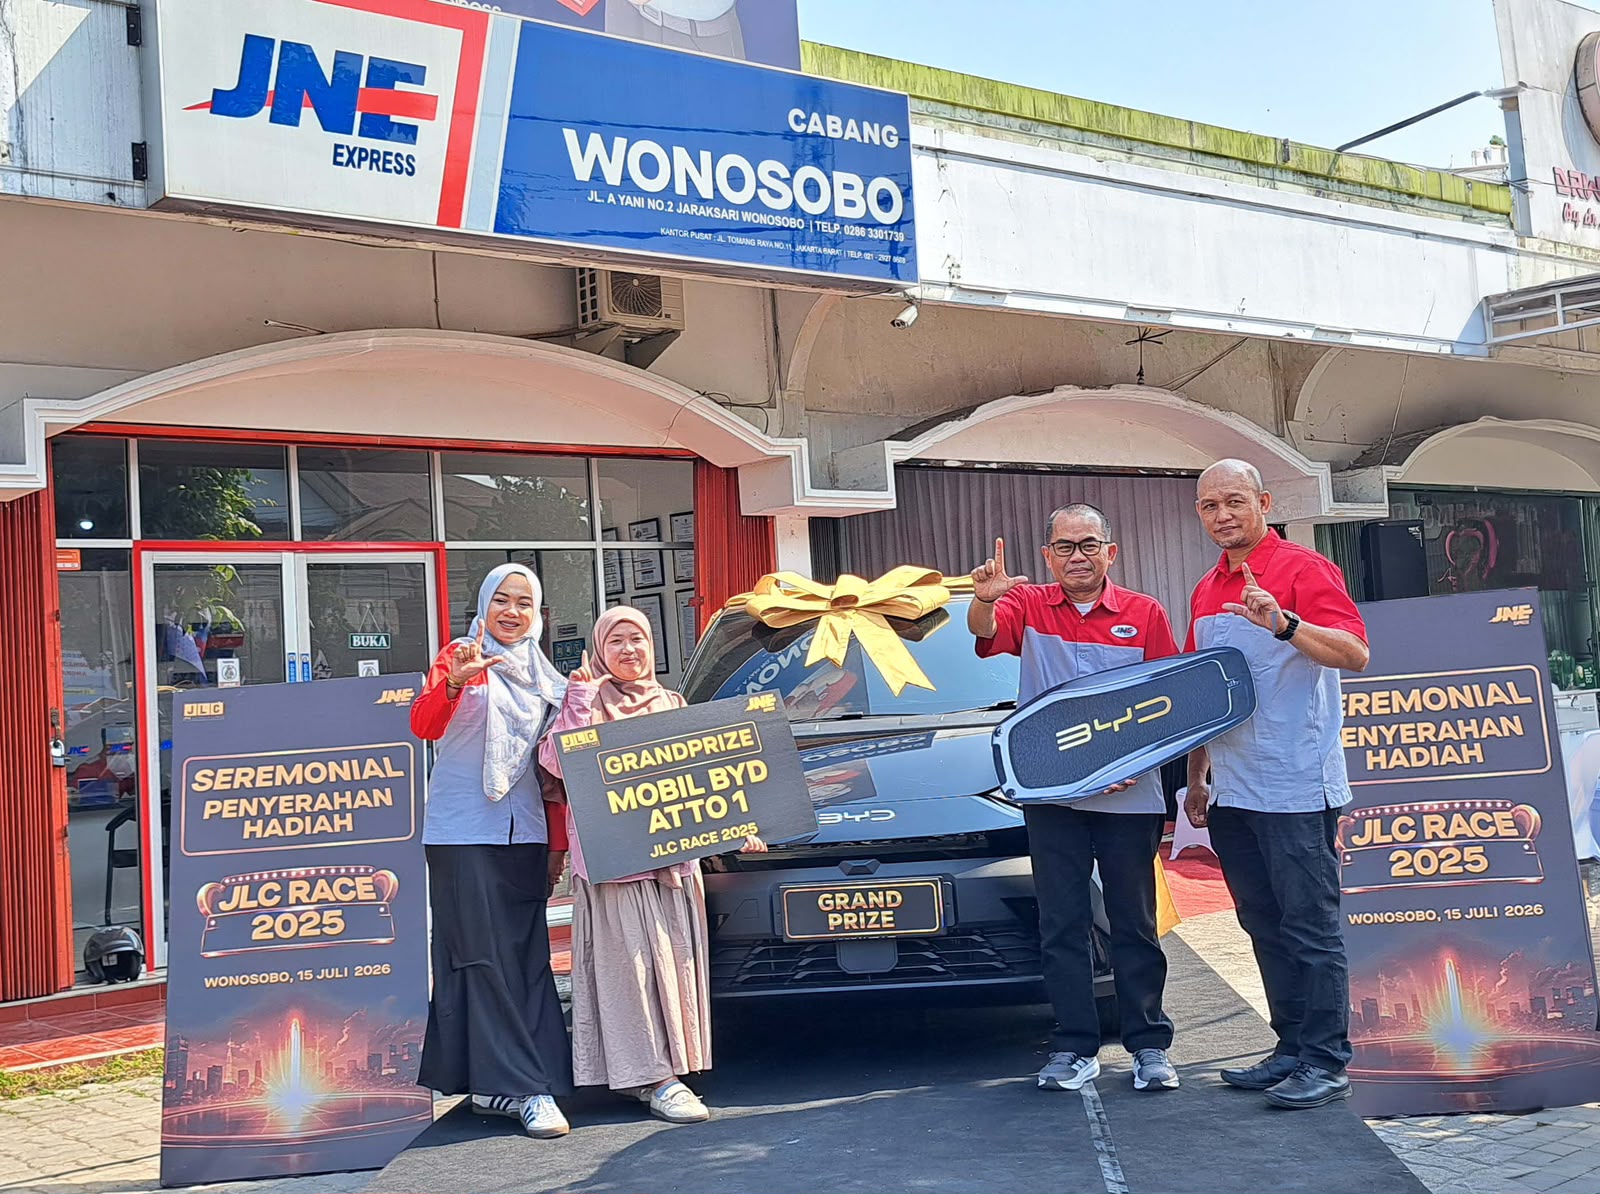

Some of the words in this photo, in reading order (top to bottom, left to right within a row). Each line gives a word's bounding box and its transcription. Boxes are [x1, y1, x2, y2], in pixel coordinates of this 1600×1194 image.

[208, 33, 439, 146] JNE
[788, 108, 899, 149] CABANG
[332, 143, 416, 177] EXPRESS
[562, 127, 904, 226] WONOSOBO
[587, 190, 605, 203] JL.
[607, 192, 617, 205] A
[617, 194, 645, 209] YANI
[647, 198, 674, 213] NO.2
[676, 202, 740, 222] JARAKSARI
[741, 211, 805, 229] WONOSOBO
[815, 220, 842, 235] TELP.
[843, 224, 866, 238] 0286
[867, 227, 905, 242] 3301739
[660, 227, 690, 238] KANTOR
[690, 230, 713, 241] PUSAT
[727, 236, 756, 247] TOMANG
[756, 239, 775, 248] RAYA
[795, 243, 823, 255] JAKARTA
[822, 247, 842, 256] BARAT
[1488, 604, 1534, 622] JNE
[352, 635, 388, 648] BUKA
[185, 702, 223, 716] JLC
[374, 687, 415, 704] JNE
[744, 693, 777, 711] JNE
[1341, 681, 1533, 718] REMONIAL
[562, 729, 598, 748] JLC
[1055, 695, 1173, 751] BYD
[1341, 715, 1524, 748] ENYERAHAN
[604, 728, 755, 776] GRANDPRIZE
[1366, 742, 1485, 771] HADIAH
[191, 756, 405, 793] SEREMONIAL
[606, 773, 706, 814] MOBIL
[707, 759, 768, 793] BYD
[202, 787, 394, 820] PENYERAHAN
[648, 795, 728, 834] ATTO
[732, 790, 750, 813] 1
[818, 809, 896, 824] BYD
[242, 812, 354, 840] HADIAH
[650, 841, 678, 859] JLC
[680, 831, 719, 851] RACE
[720, 822, 759, 840] 2025
[1351, 815, 1417, 847] JLC
[1422, 811, 1520, 840] RACE
[1388, 845, 1490, 877] 2025
[218, 881, 282, 912] JLC
[288, 876, 377, 905] RACE
[817, 890, 904, 912] GRAND
[251, 909, 346, 941] 2025
[828, 910, 896, 931] PRIZE
[1347, 909, 1441, 926] WONOSOBO,
[1444, 908, 1462, 920] 15
[1464, 906, 1498, 919] JULI
[1504, 904, 1544, 917] 2026
[204, 971, 294, 989] WONOSOBO,
[297, 969, 313, 982] 15
[316, 966, 348, 980] JULI
[353, 963, 391, 977] 2026
